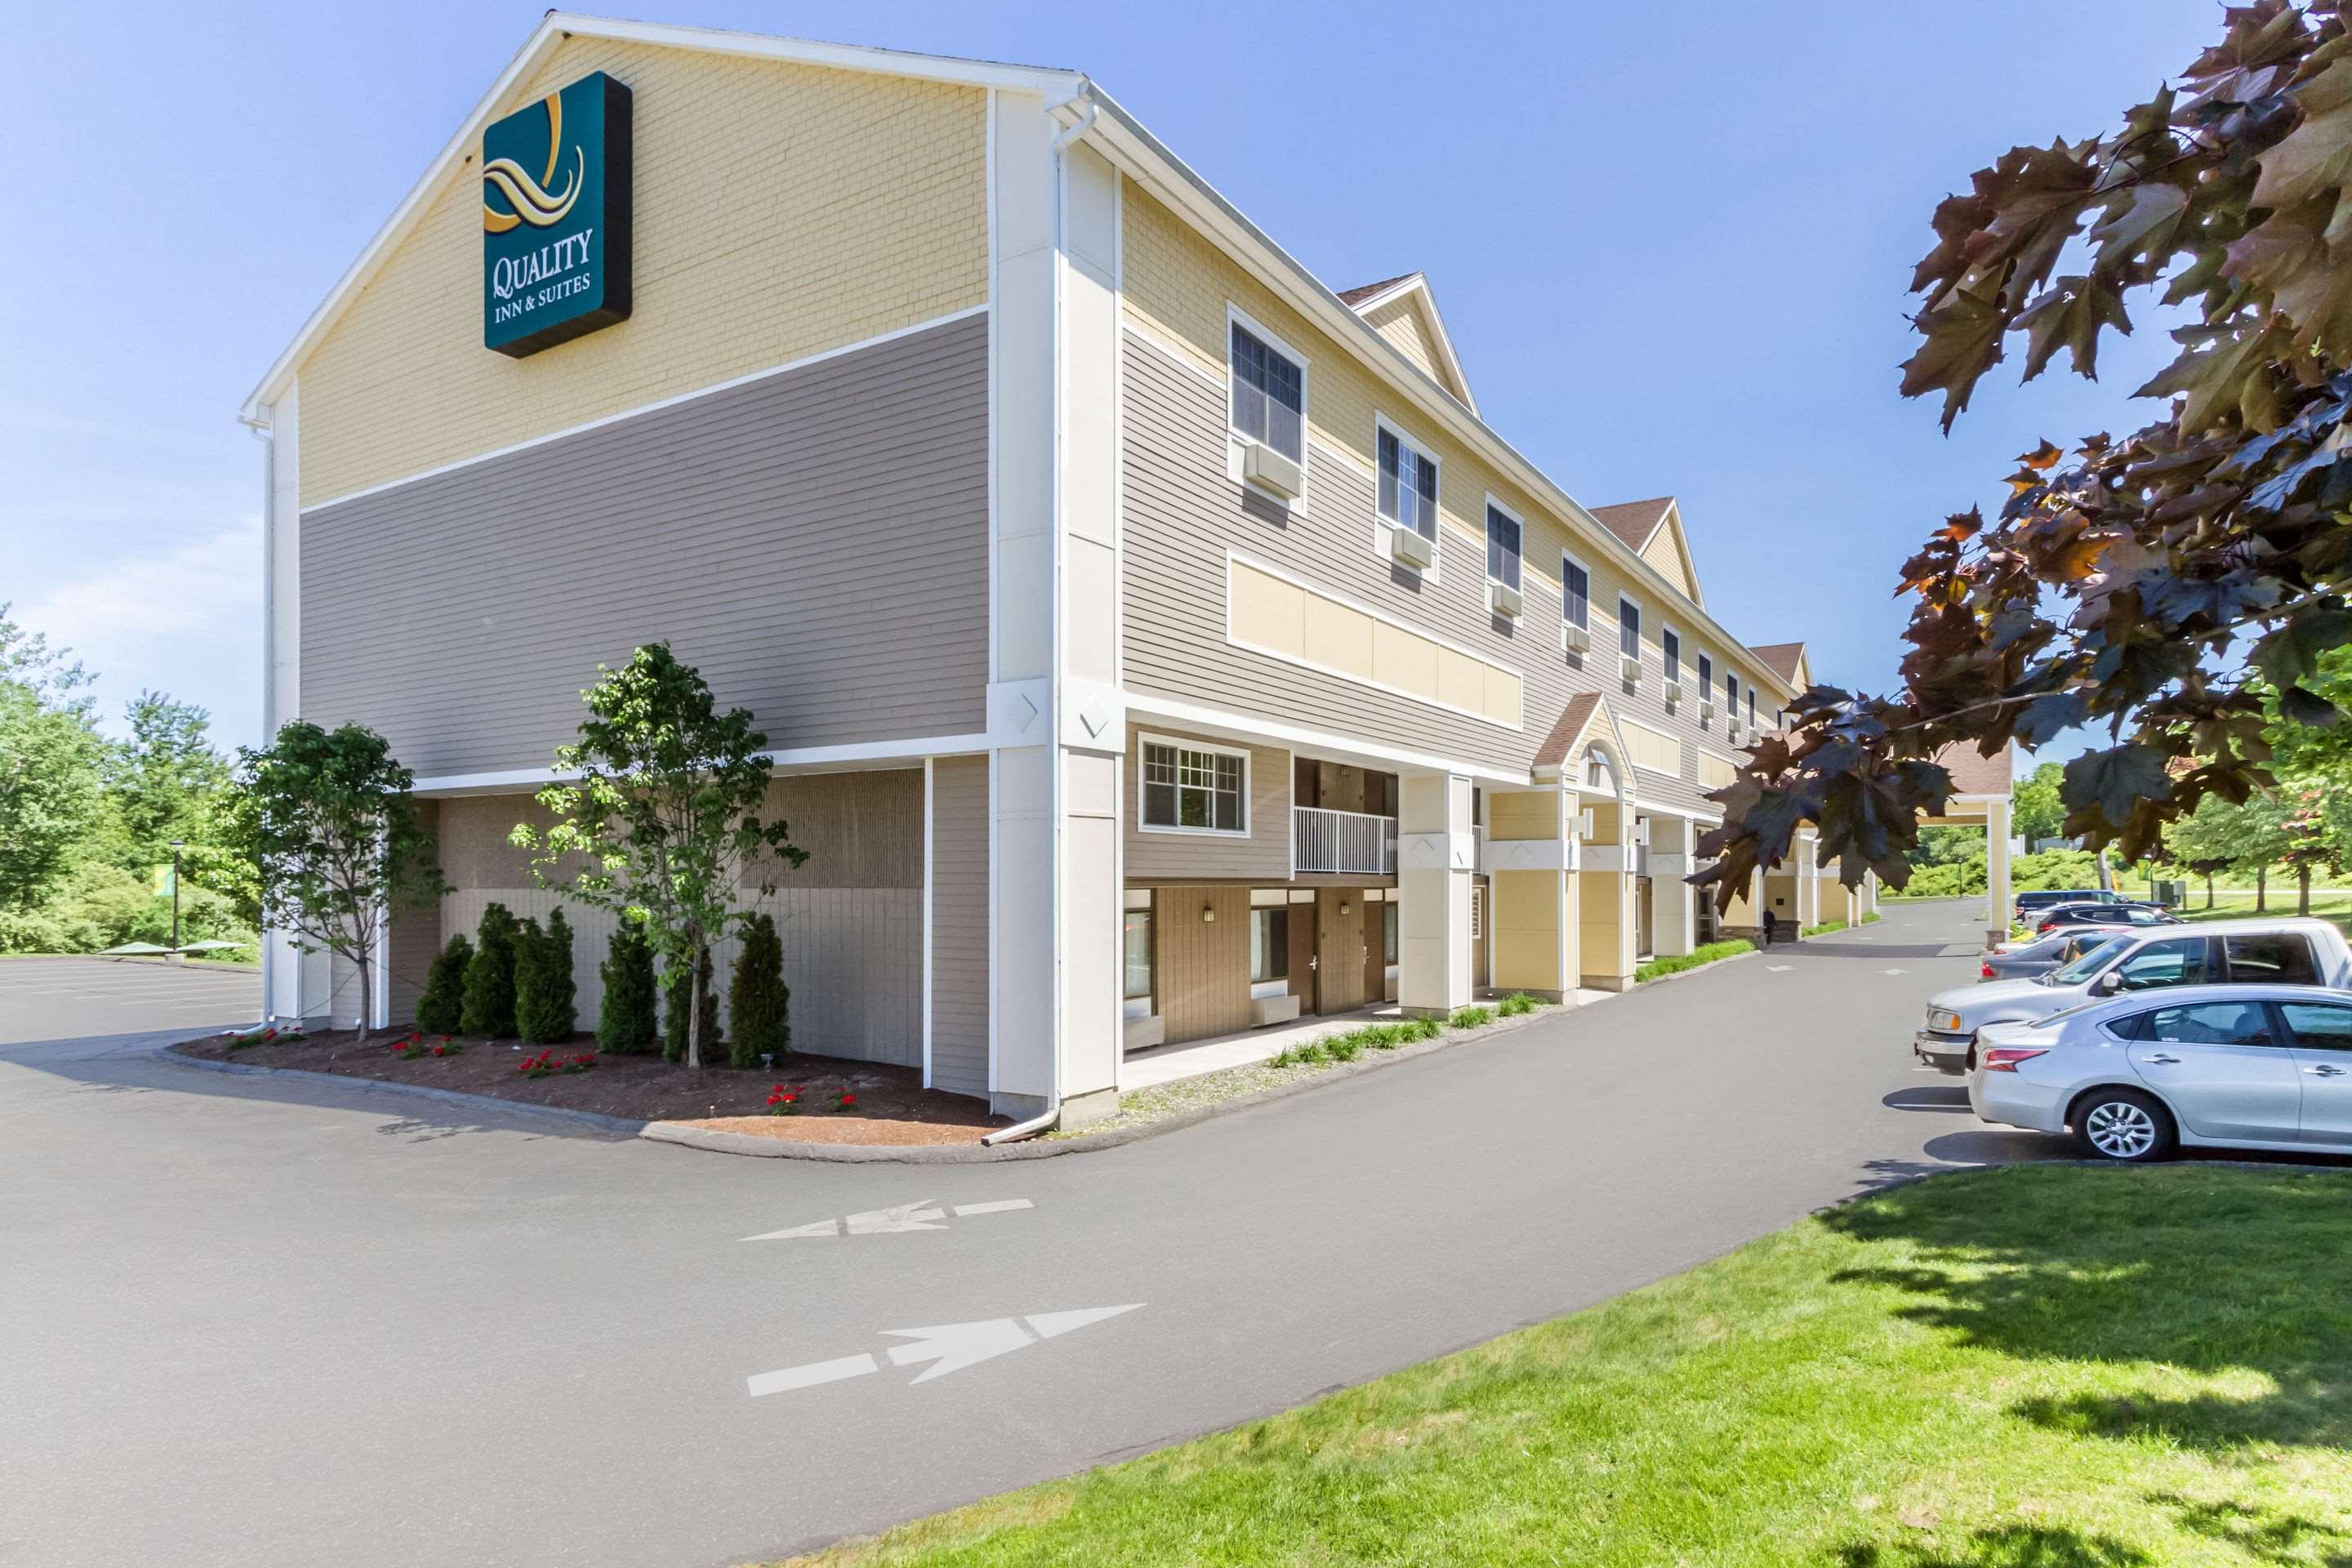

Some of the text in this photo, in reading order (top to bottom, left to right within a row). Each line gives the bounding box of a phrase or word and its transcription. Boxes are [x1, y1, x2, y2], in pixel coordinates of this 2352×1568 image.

[493, 228, 593, 300] QUALITY
[495, 273, 590, 324] INN & SUITES
